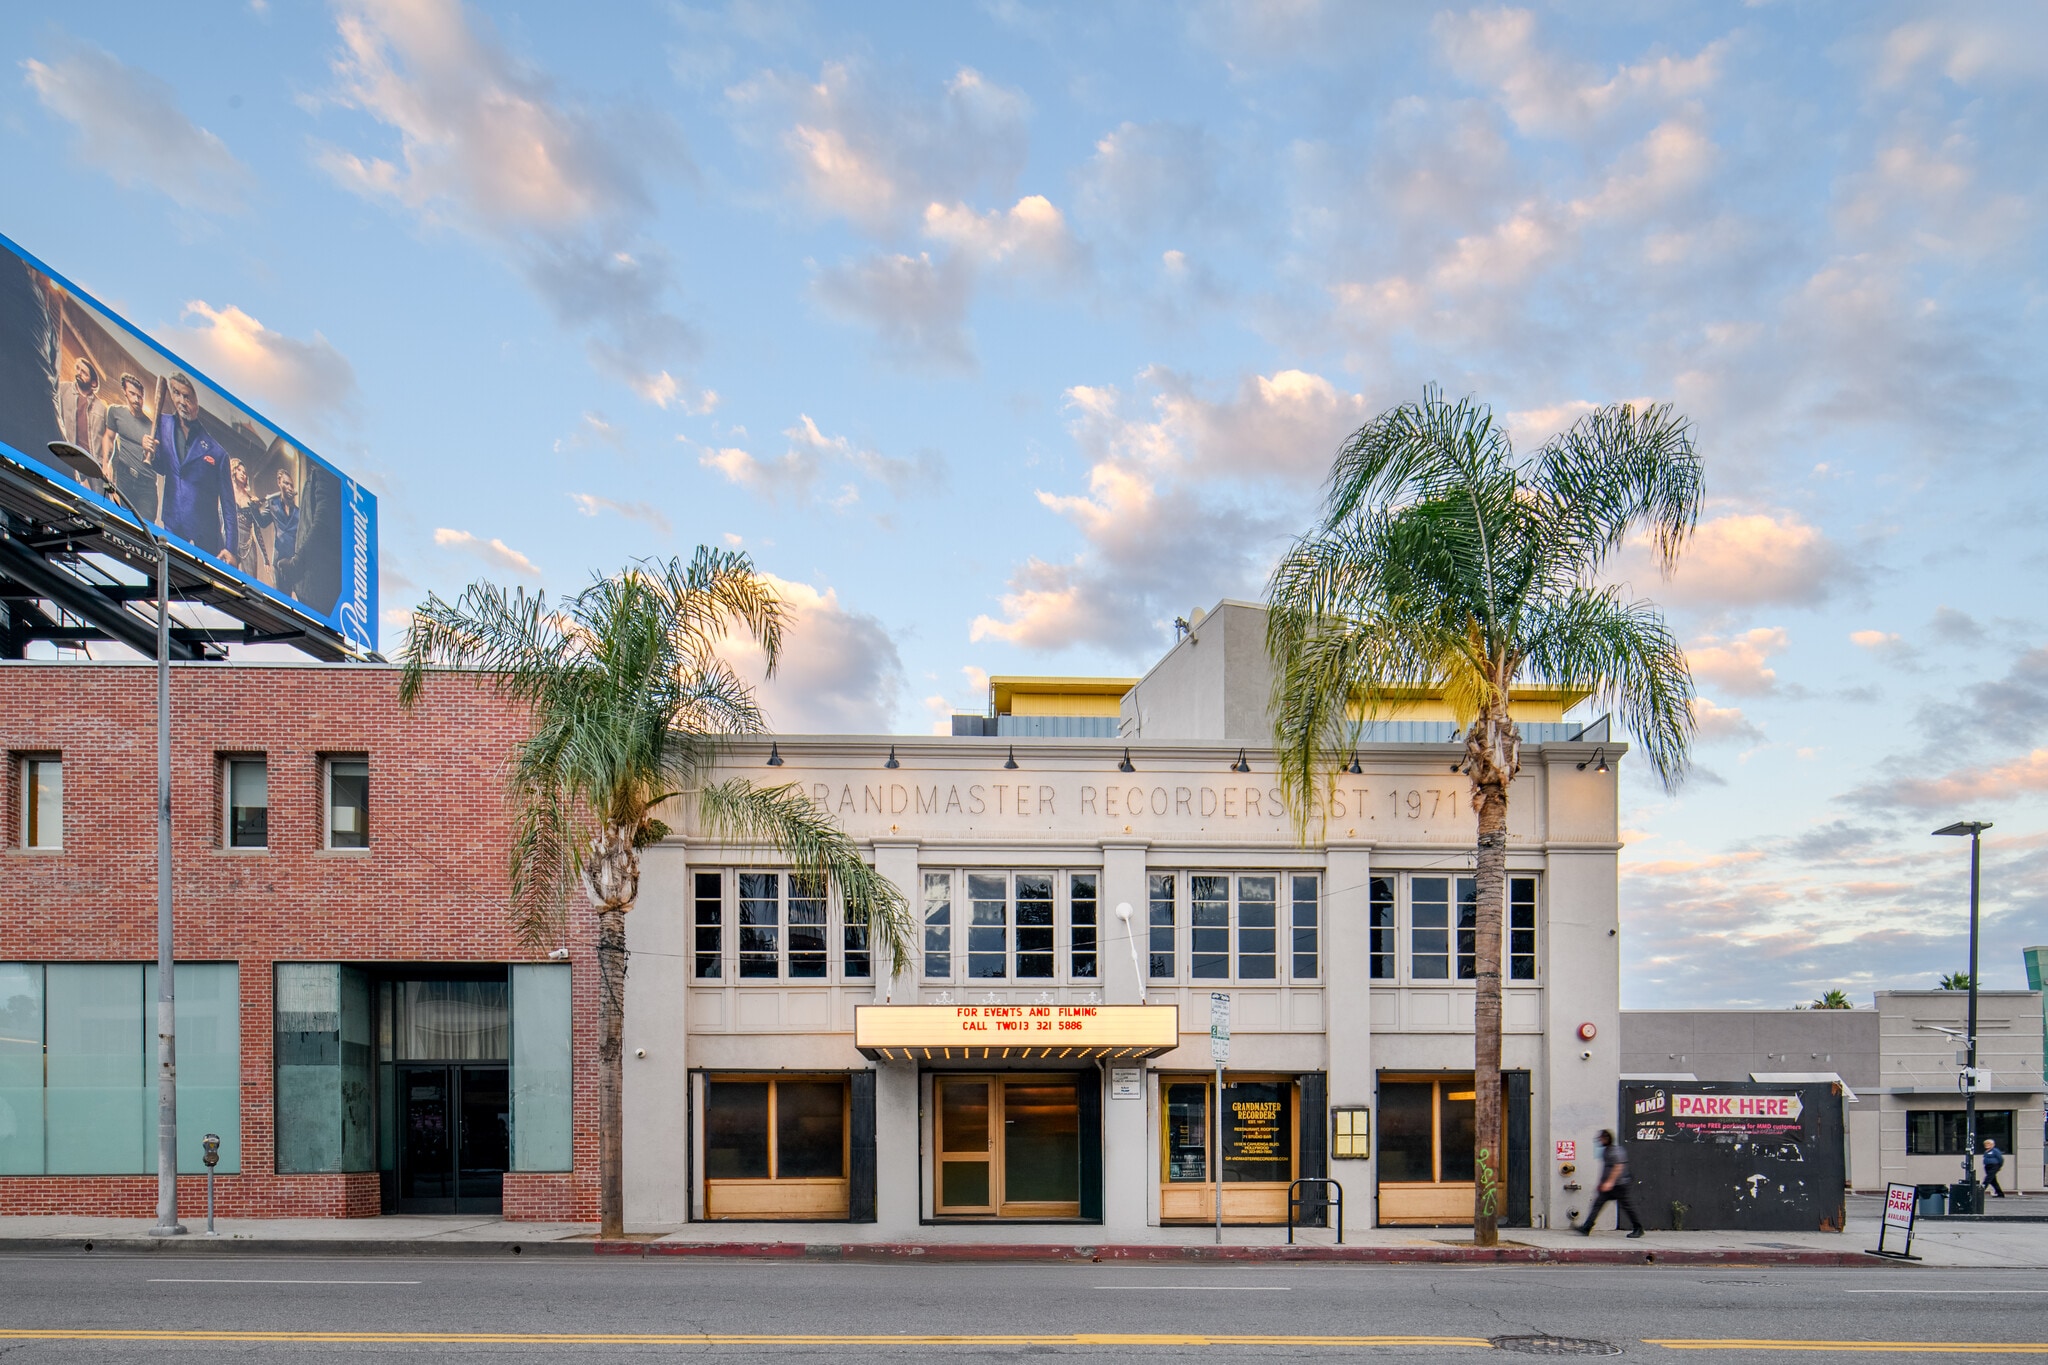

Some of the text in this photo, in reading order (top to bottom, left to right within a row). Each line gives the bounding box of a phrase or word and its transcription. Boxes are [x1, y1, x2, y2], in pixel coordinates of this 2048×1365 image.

[787, 783, 1055, 815] RANDMASTER
[1081, 786, 1285, 817] RECORDERS
[1389, 789, 1458, 818] 1971
[957, 1008, 1097, 1017] FOR EVENTS AND FILMING
[962, 1021, 988, 1031] CALL
[1036, 1021, 1052, 1031] 321
[1058, 1021, 1083, 1031] 5886
[1232, 1102, 1281, 1111] GRANDMASTER
[1635, 1096, 1666, 1115] MMD
[1680, 1097, 1788, 1116] PARK HERE
[1237, 1110, 1276, 1120] RECORDERS
[1722, 1122, 1746, 1131] parking
[1891, 1190, 1912, 1201] SELF
[1888, 1200, 1912, 1212] PARK
[1888, 1213, 1909, 1222] AVAILABLE
